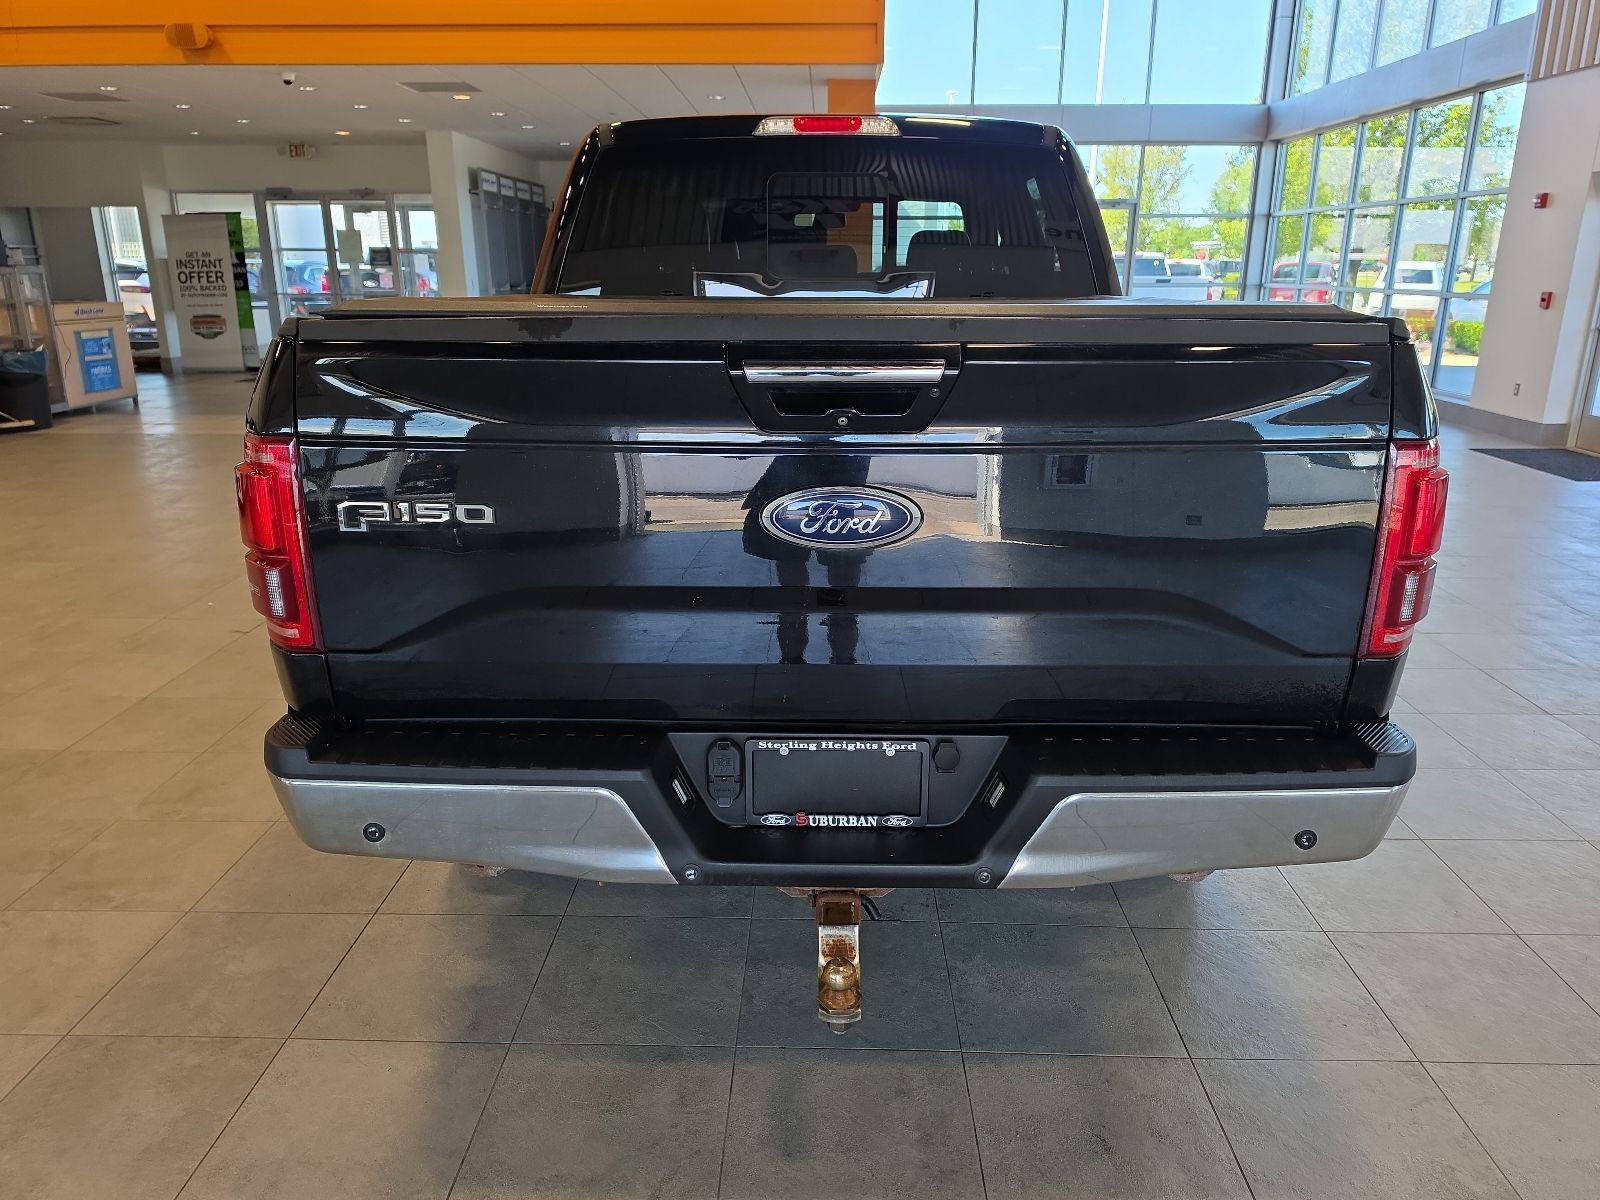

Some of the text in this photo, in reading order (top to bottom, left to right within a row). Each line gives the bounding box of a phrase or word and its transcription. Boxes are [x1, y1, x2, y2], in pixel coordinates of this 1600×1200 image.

[289, 144, 306, 158] EXIT
[185, 251, 199, 259] GET
[175, 258, 224, 270] INSTANT
[177, 270, 225, 284] OFFER
[179, 284, 227, 293] 100% BACKED
[800, 499, 884, 535] Ford
[758, 741, 918, 751] Sterling Heights Ford
[795, 811, 878, 827] SUBURBAN
